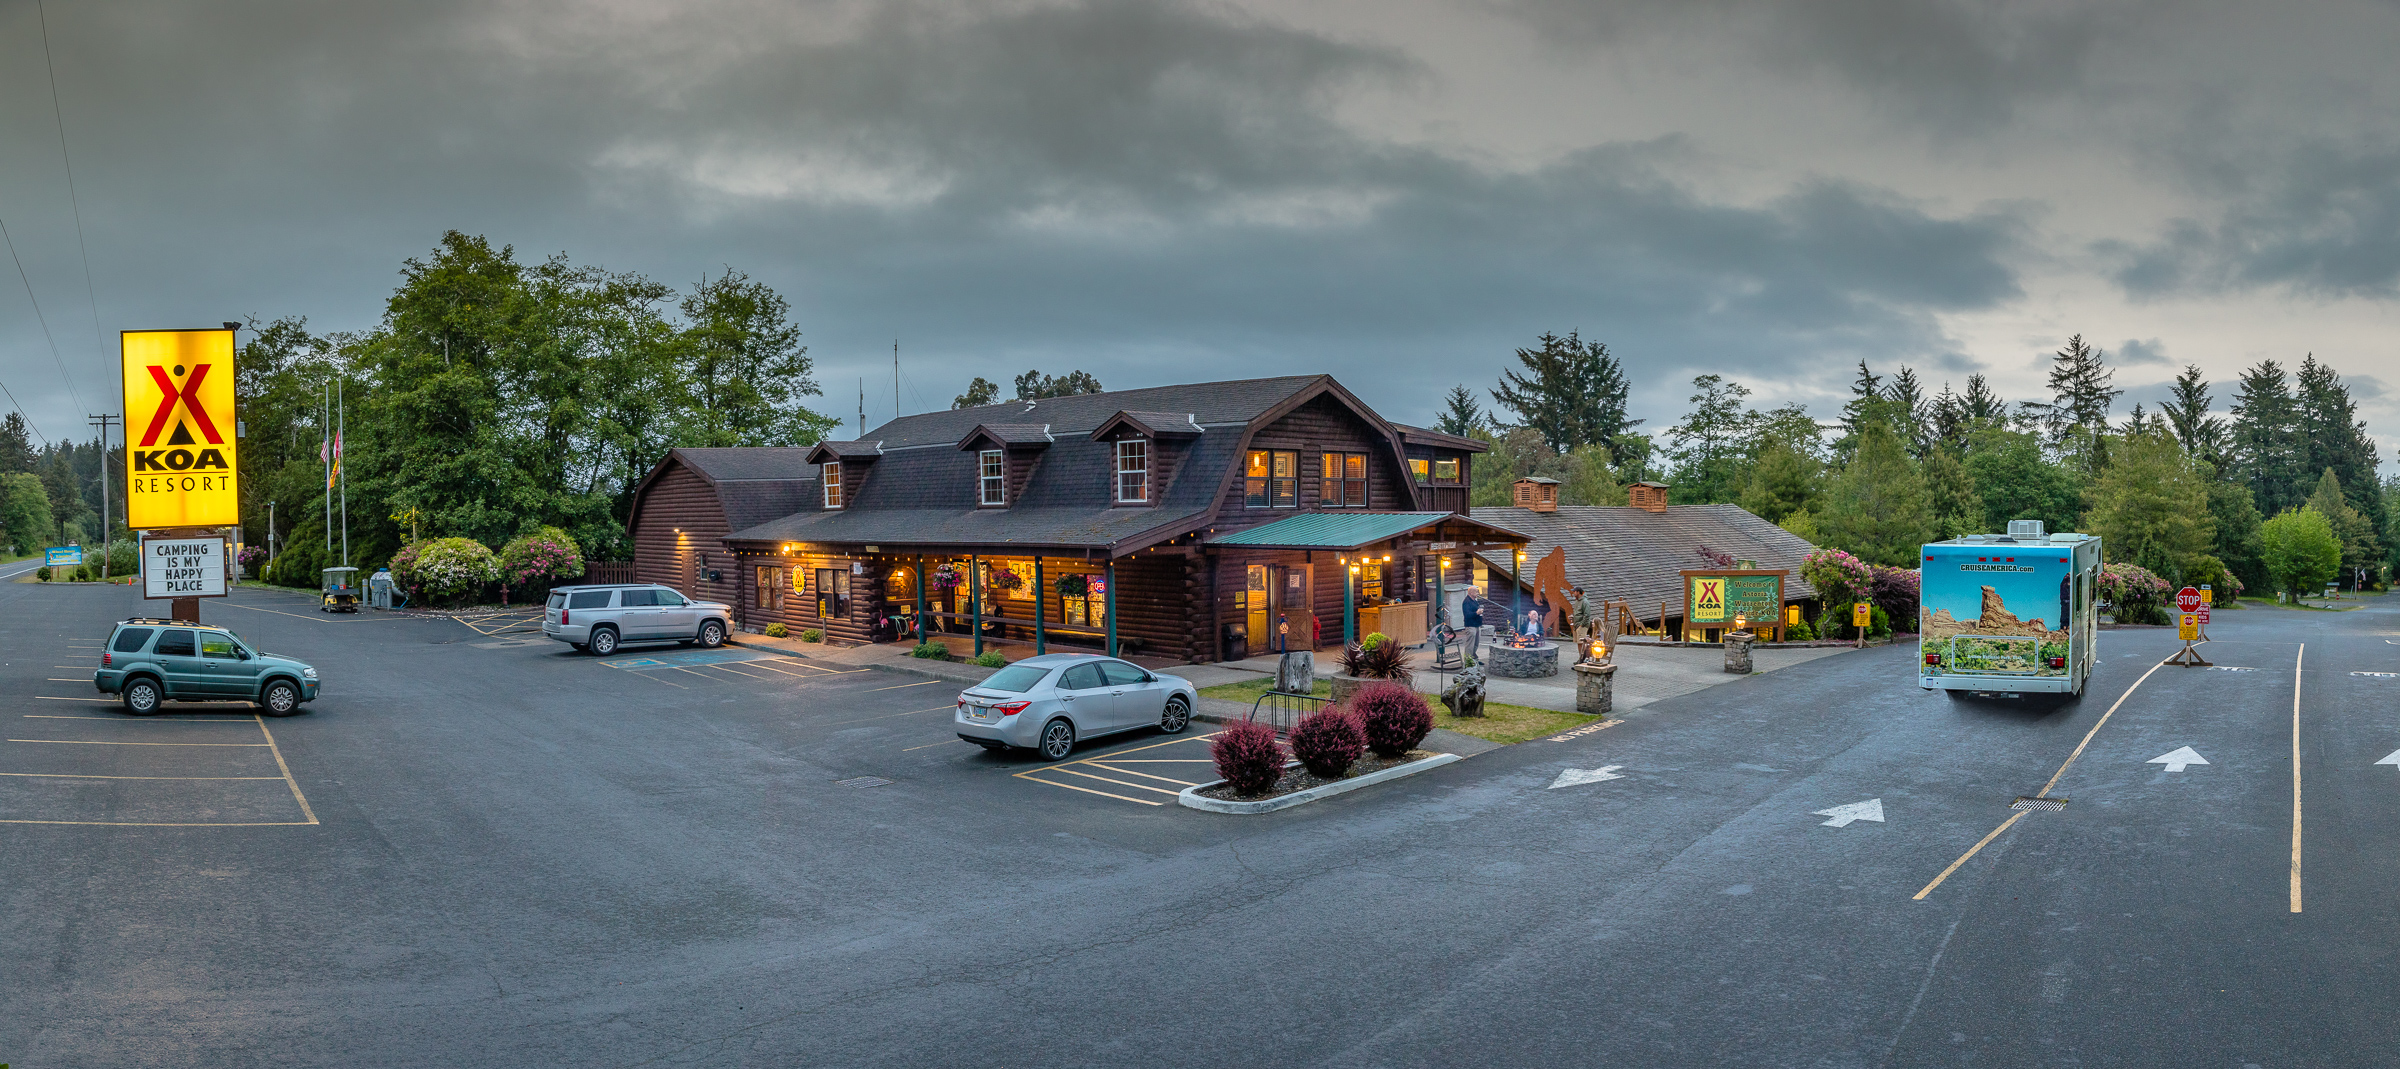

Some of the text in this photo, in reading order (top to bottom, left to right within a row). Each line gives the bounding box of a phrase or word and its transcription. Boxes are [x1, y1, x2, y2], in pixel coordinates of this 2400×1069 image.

[134, 449, 229, 471] KOA
[135, 476, 229, 493] RESORT
[157, 544, 208, 556] CAMPING
[167, 557, 201, 568] IS MY
[1960, 564, 2034, 573] CRUISEAMERICA.com
[166, 569, 203, 579] HAPPY
[167, 581, 202, 591] PLACE
[2178, 595, 2200, 605] STOP
